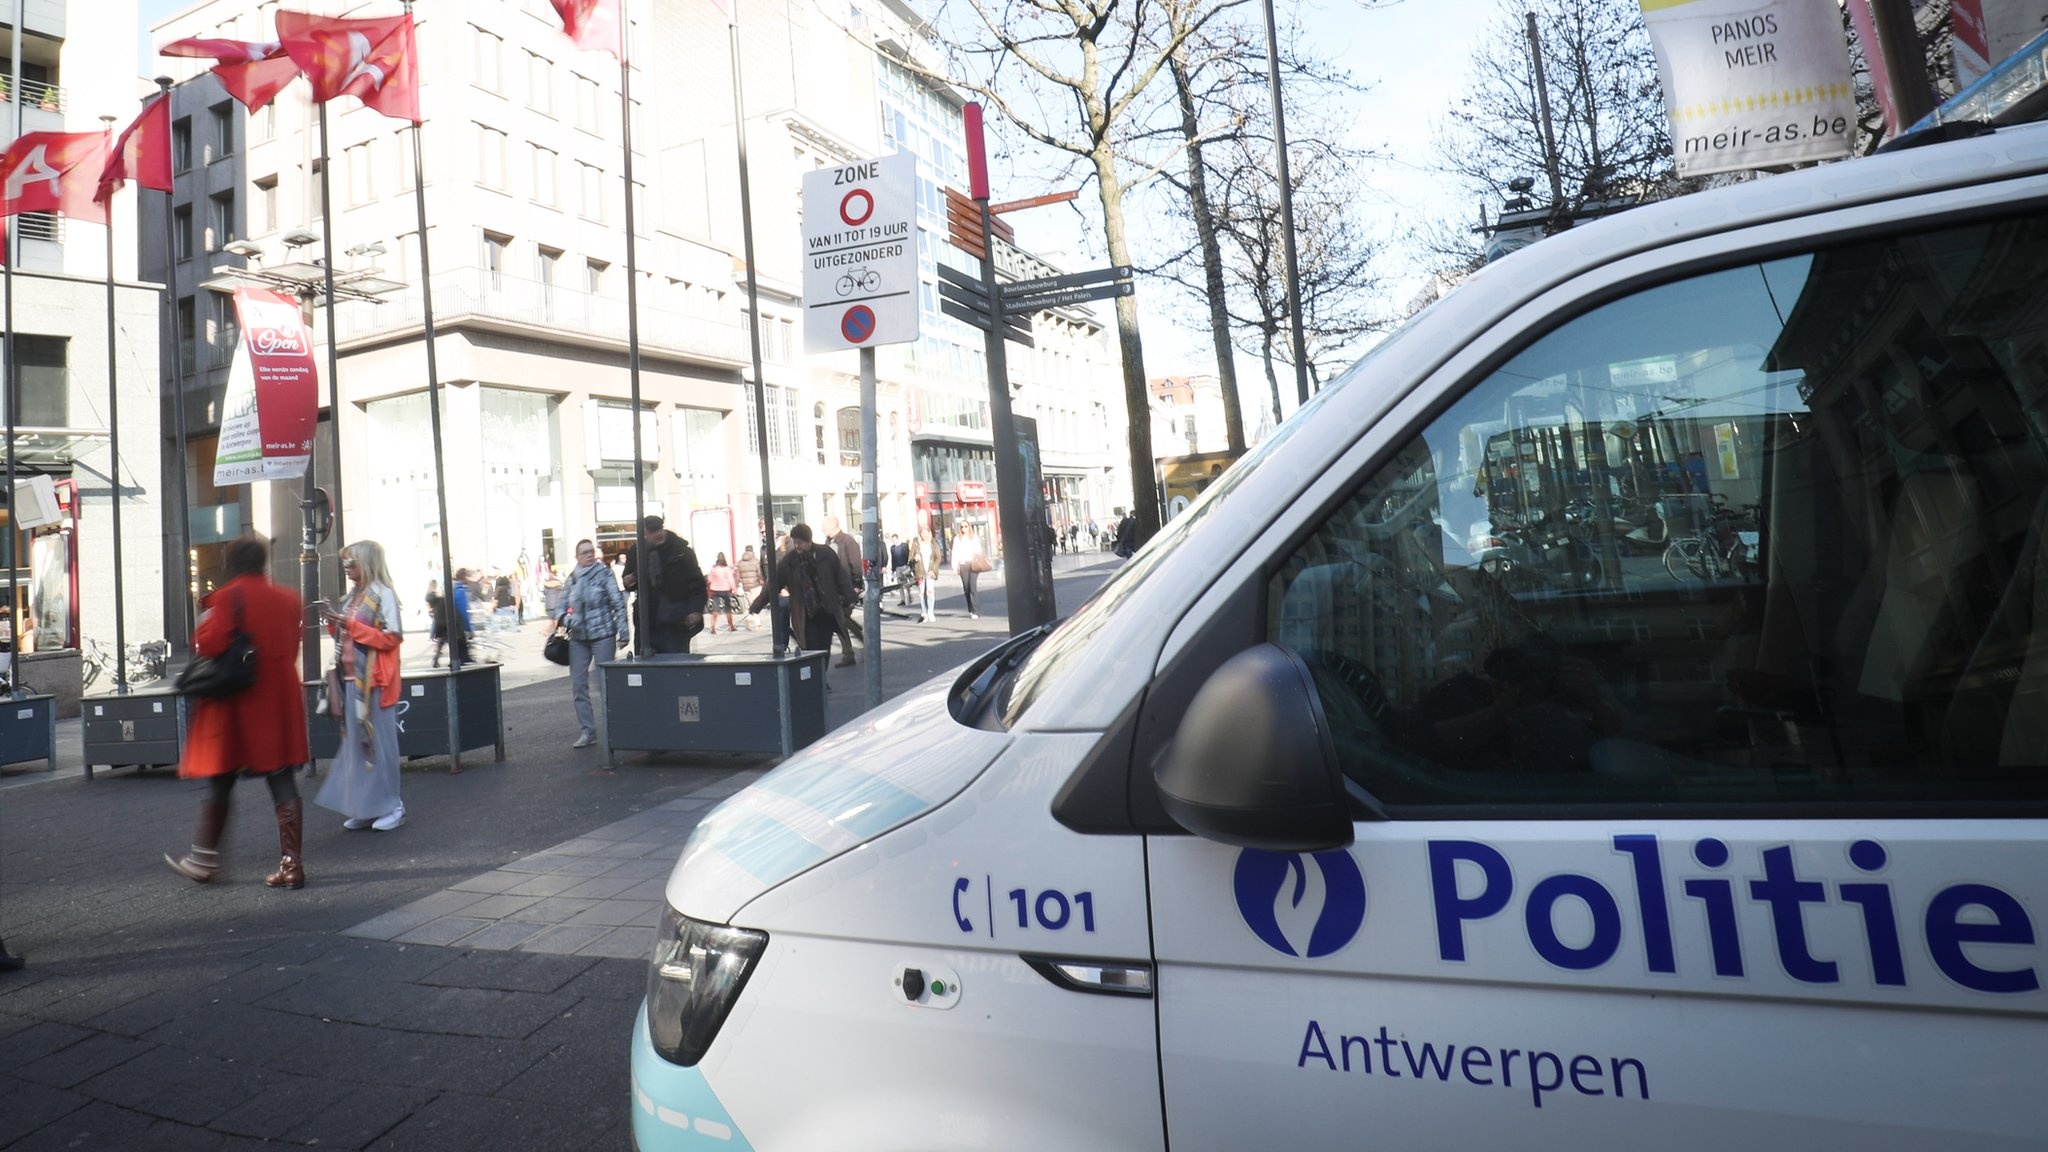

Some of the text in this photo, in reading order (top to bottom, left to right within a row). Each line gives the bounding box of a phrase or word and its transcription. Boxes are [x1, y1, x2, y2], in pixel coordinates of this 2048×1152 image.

[1711, 14, 1778, 44] PANOS
[1725, 42, 1778, 70] MEIR
[1685, 115, 1847, 153] meir-as.be
[834, 162, 880, 186] ZONE
[809, 222, 908, 249] VAN 11 TOT 19 UUR
[814, 244, 903, 270] UITGEZONDERD
[1003, 280, 1058, 294] Bourlaschouwburg
[1005, 296, 1056, 310] Stadsschouwburg
[1062, 293, 1073, 302] Het
[1074, 292, 1092, 301] Paleis
[257, 329, 299, 354] Open
[290, 366, 309, 374] zondag
[1009, 888, 1096, 933] 101
[1427, 834, 2041, 993] Politie
[1297, 1020, 1650, 1108] Antwerpen
